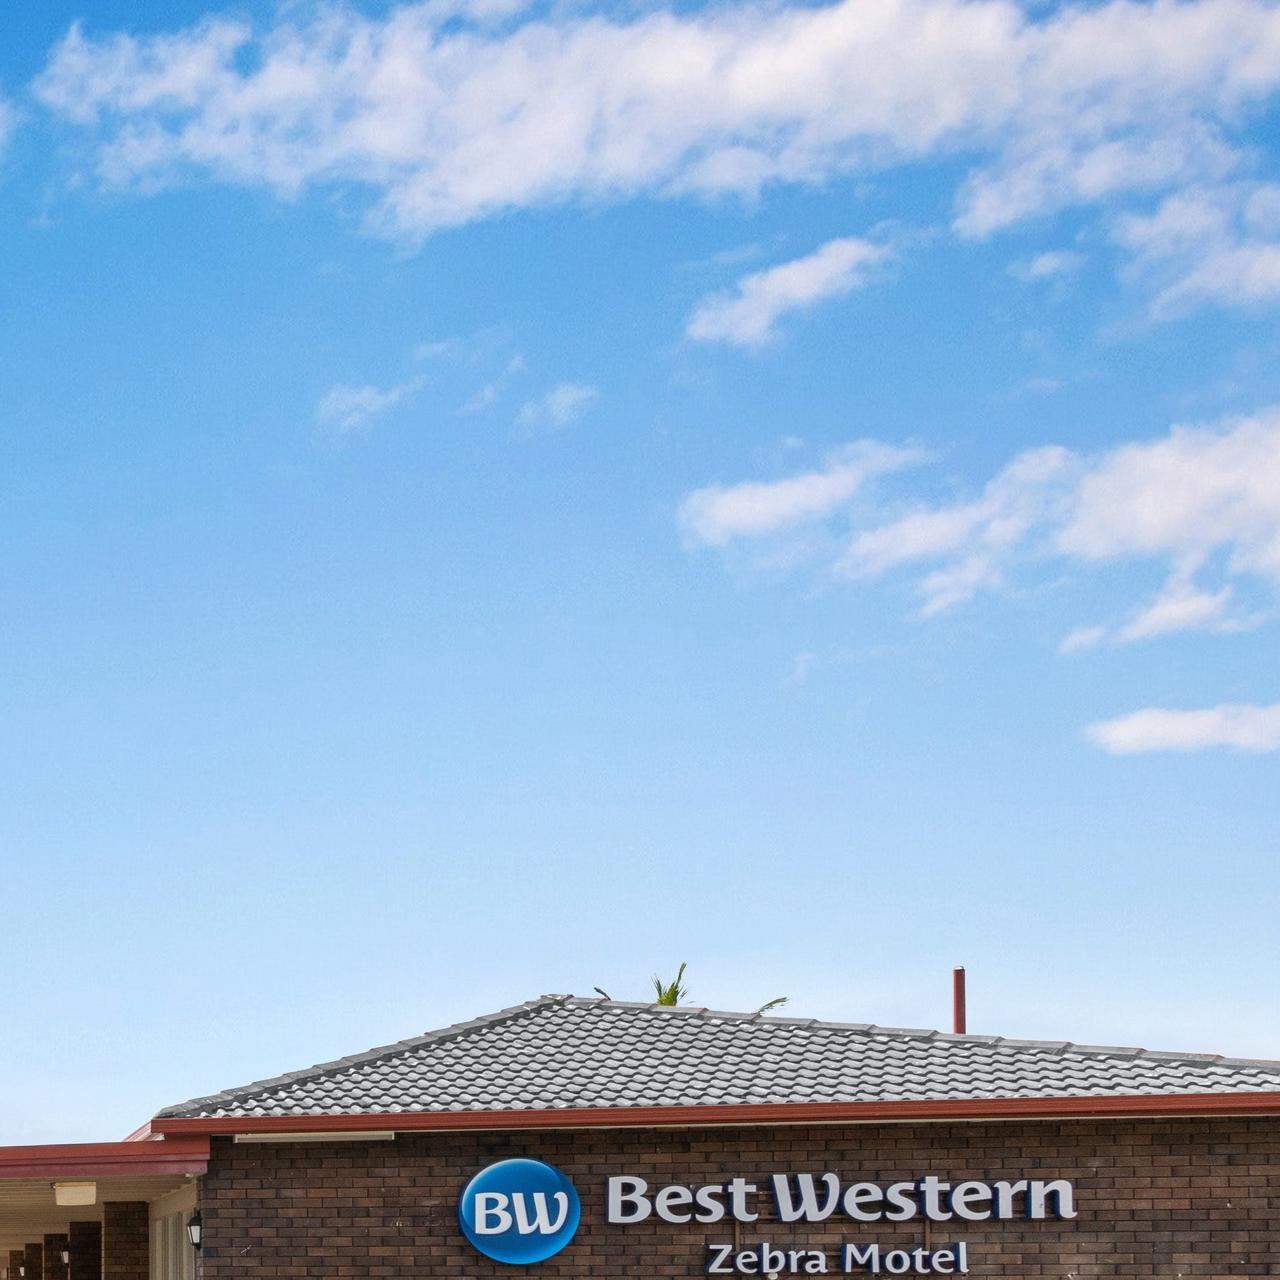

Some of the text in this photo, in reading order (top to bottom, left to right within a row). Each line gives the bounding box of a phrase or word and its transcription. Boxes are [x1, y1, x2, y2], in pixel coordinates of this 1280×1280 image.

[474, 1191, 568, 1235] BW
[606, 1172, 1078, 1224] Best Western
[707, 1241, 970, 1274] Zebra Motel
